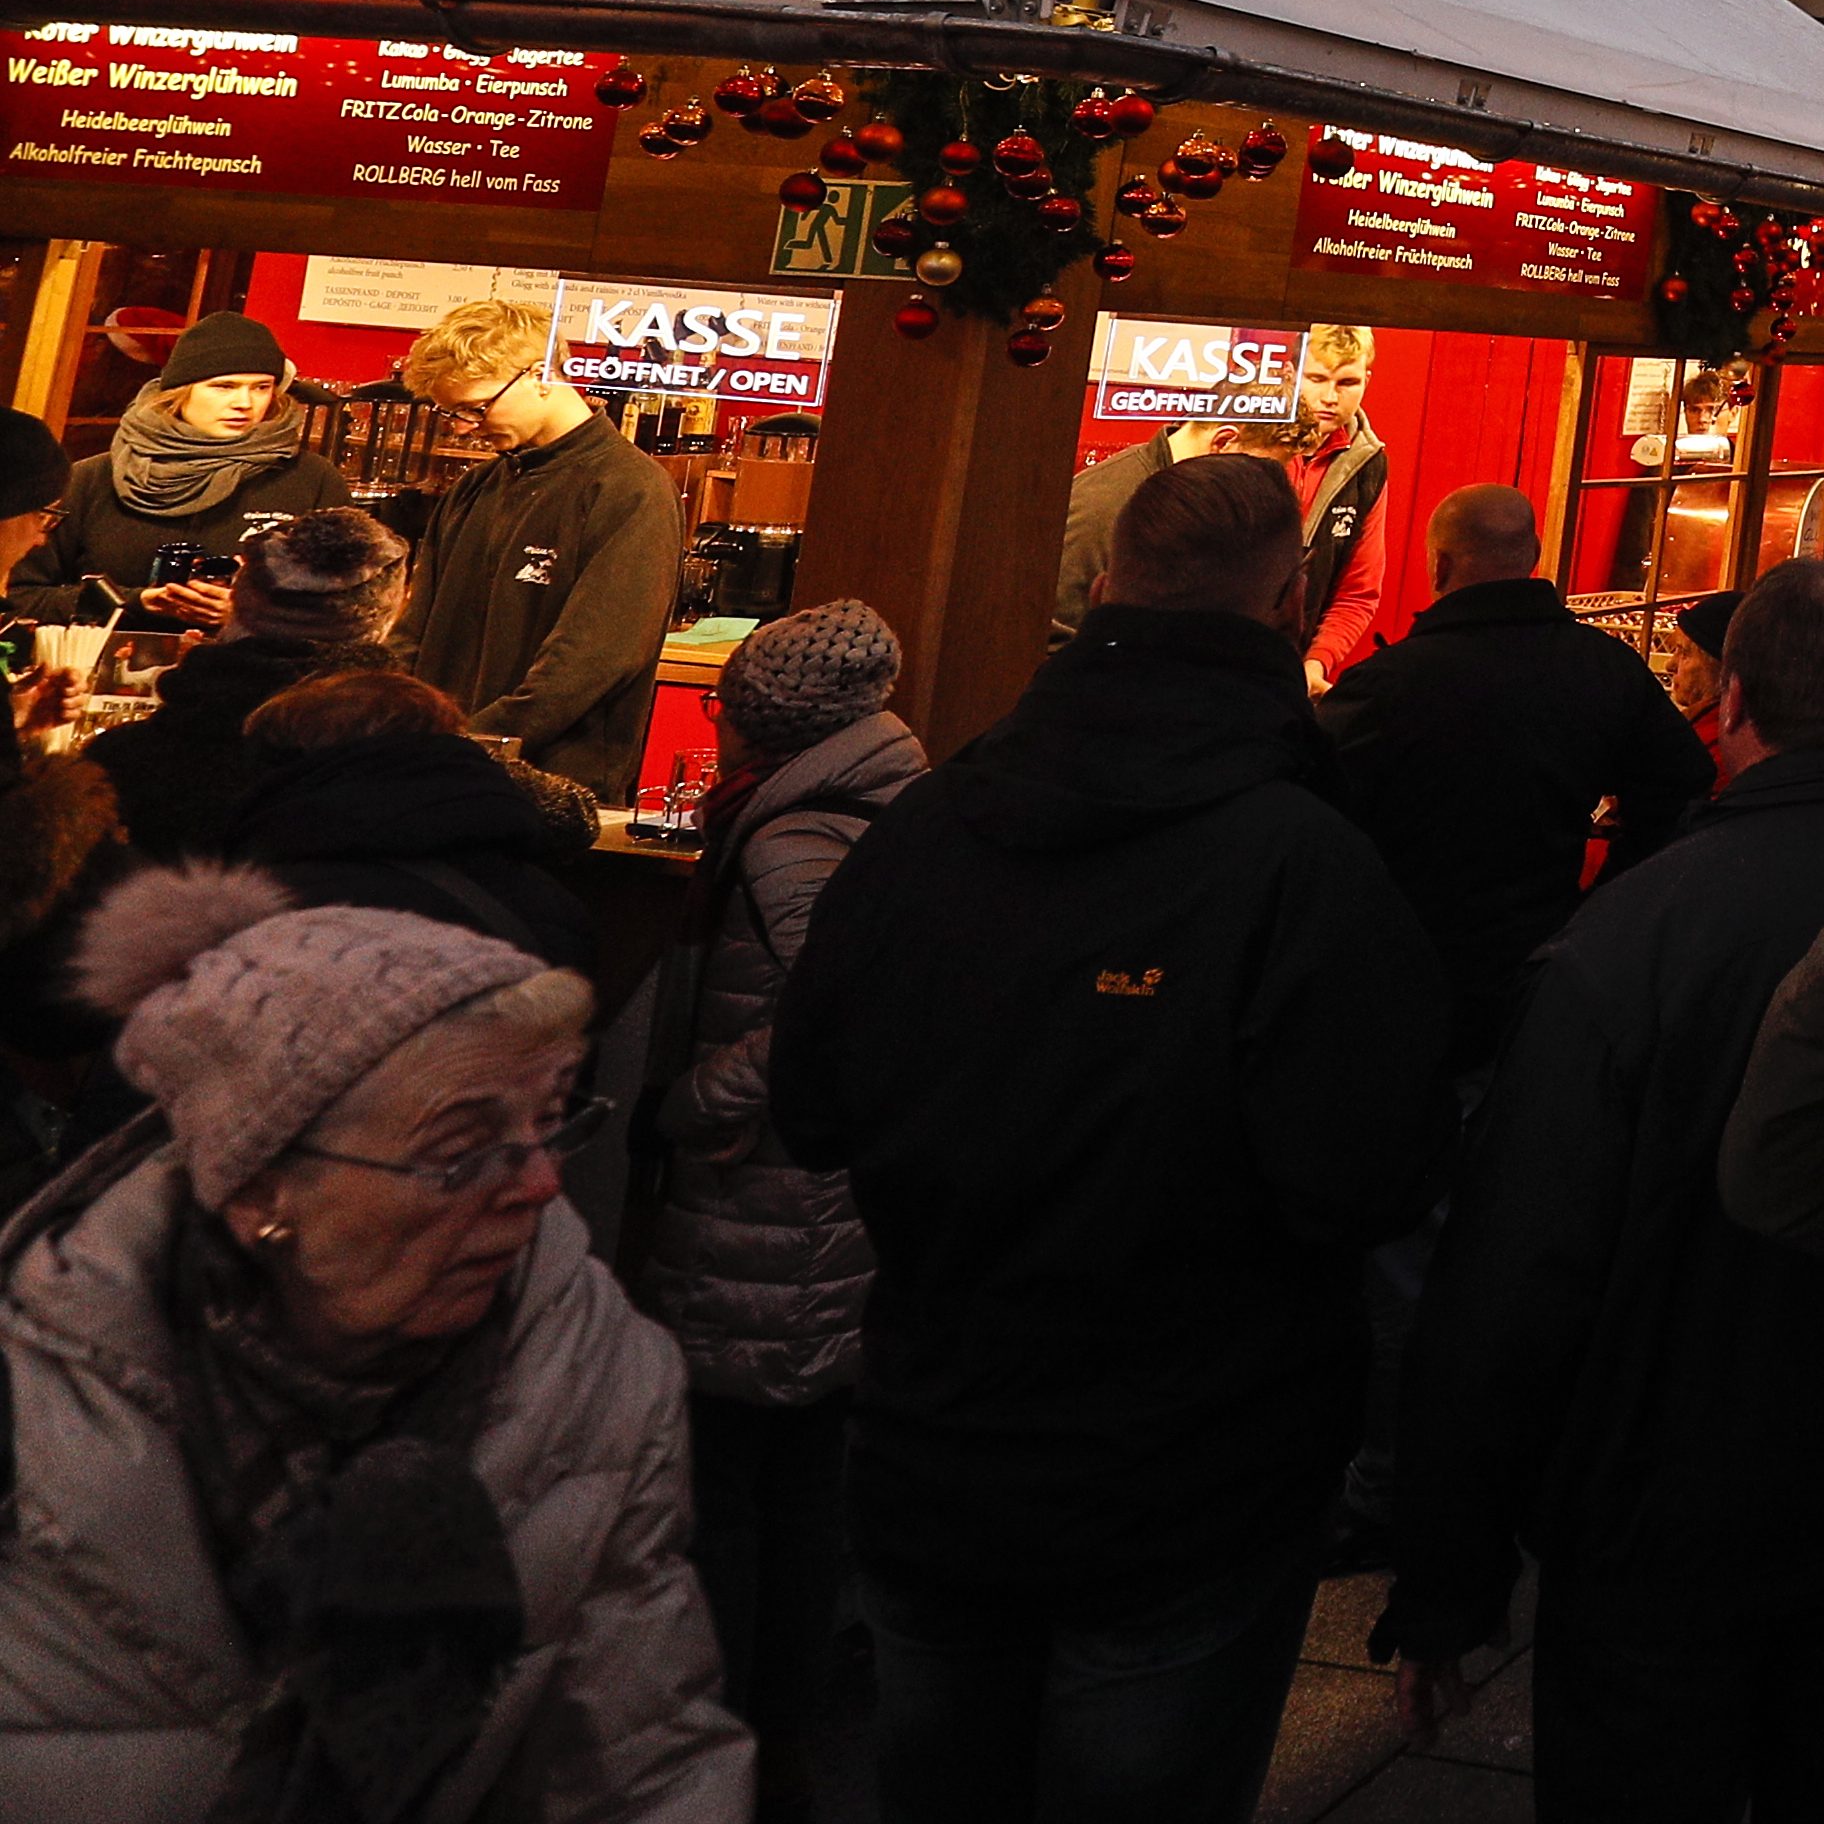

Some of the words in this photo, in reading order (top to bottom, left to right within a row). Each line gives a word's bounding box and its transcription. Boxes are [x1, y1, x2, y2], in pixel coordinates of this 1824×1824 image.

[24, 22, 100, 43] oter
[7, 57, 99, 87] Weißer
[108, 62, 299, 100] Winzerglühwein
[380, 70, 461, 92] Lumumba
[475, 74, 569, 99] Eierpunsch
[60, 109, 232, 139] Heidelbeerglühwein
[9, 141, 128, 166] Alkoholfreier
[132, 148, 263, 177] Früchtepunsch
[406, 134, 472, 156] Wasser
[490, 139, 521, 159] Tee
[352, 163, 446, 187] ROLLBERG
[450, 168, 483, 189] hell
[485, 175, 519, 191] vom
[522, 173, 562, 193] Fass
[1378, 169, 1495, 209] Winzerglühwein
[1347, 208, 1457, 239] Heidelbeerglühwein
[1312, 237, 1393, 262] Alkoholfreier
[1394, 245, 1473, 271] Früchtepunsch
[1548, 241, 1580, 259] Wasser
[1586, 246, 1602, 262] Tee
[1520, 262, 1567, 282] ROLLBERG
[1601, 271, 1621, 287] Fass
[583, 298, 807, 362] KASSE
[1127, 335, 1288, 386] KASSE
[561, 355, 706, 388] GEÖFFNET
[706, 367, 728, 391] /
[728, 369, 810, 397] OPEN
[1110, 388, 1219, 413] GEÖFFNET
[1216, 395, 1233, 416] /
[1233, 395, 1287, 415] OPEN
